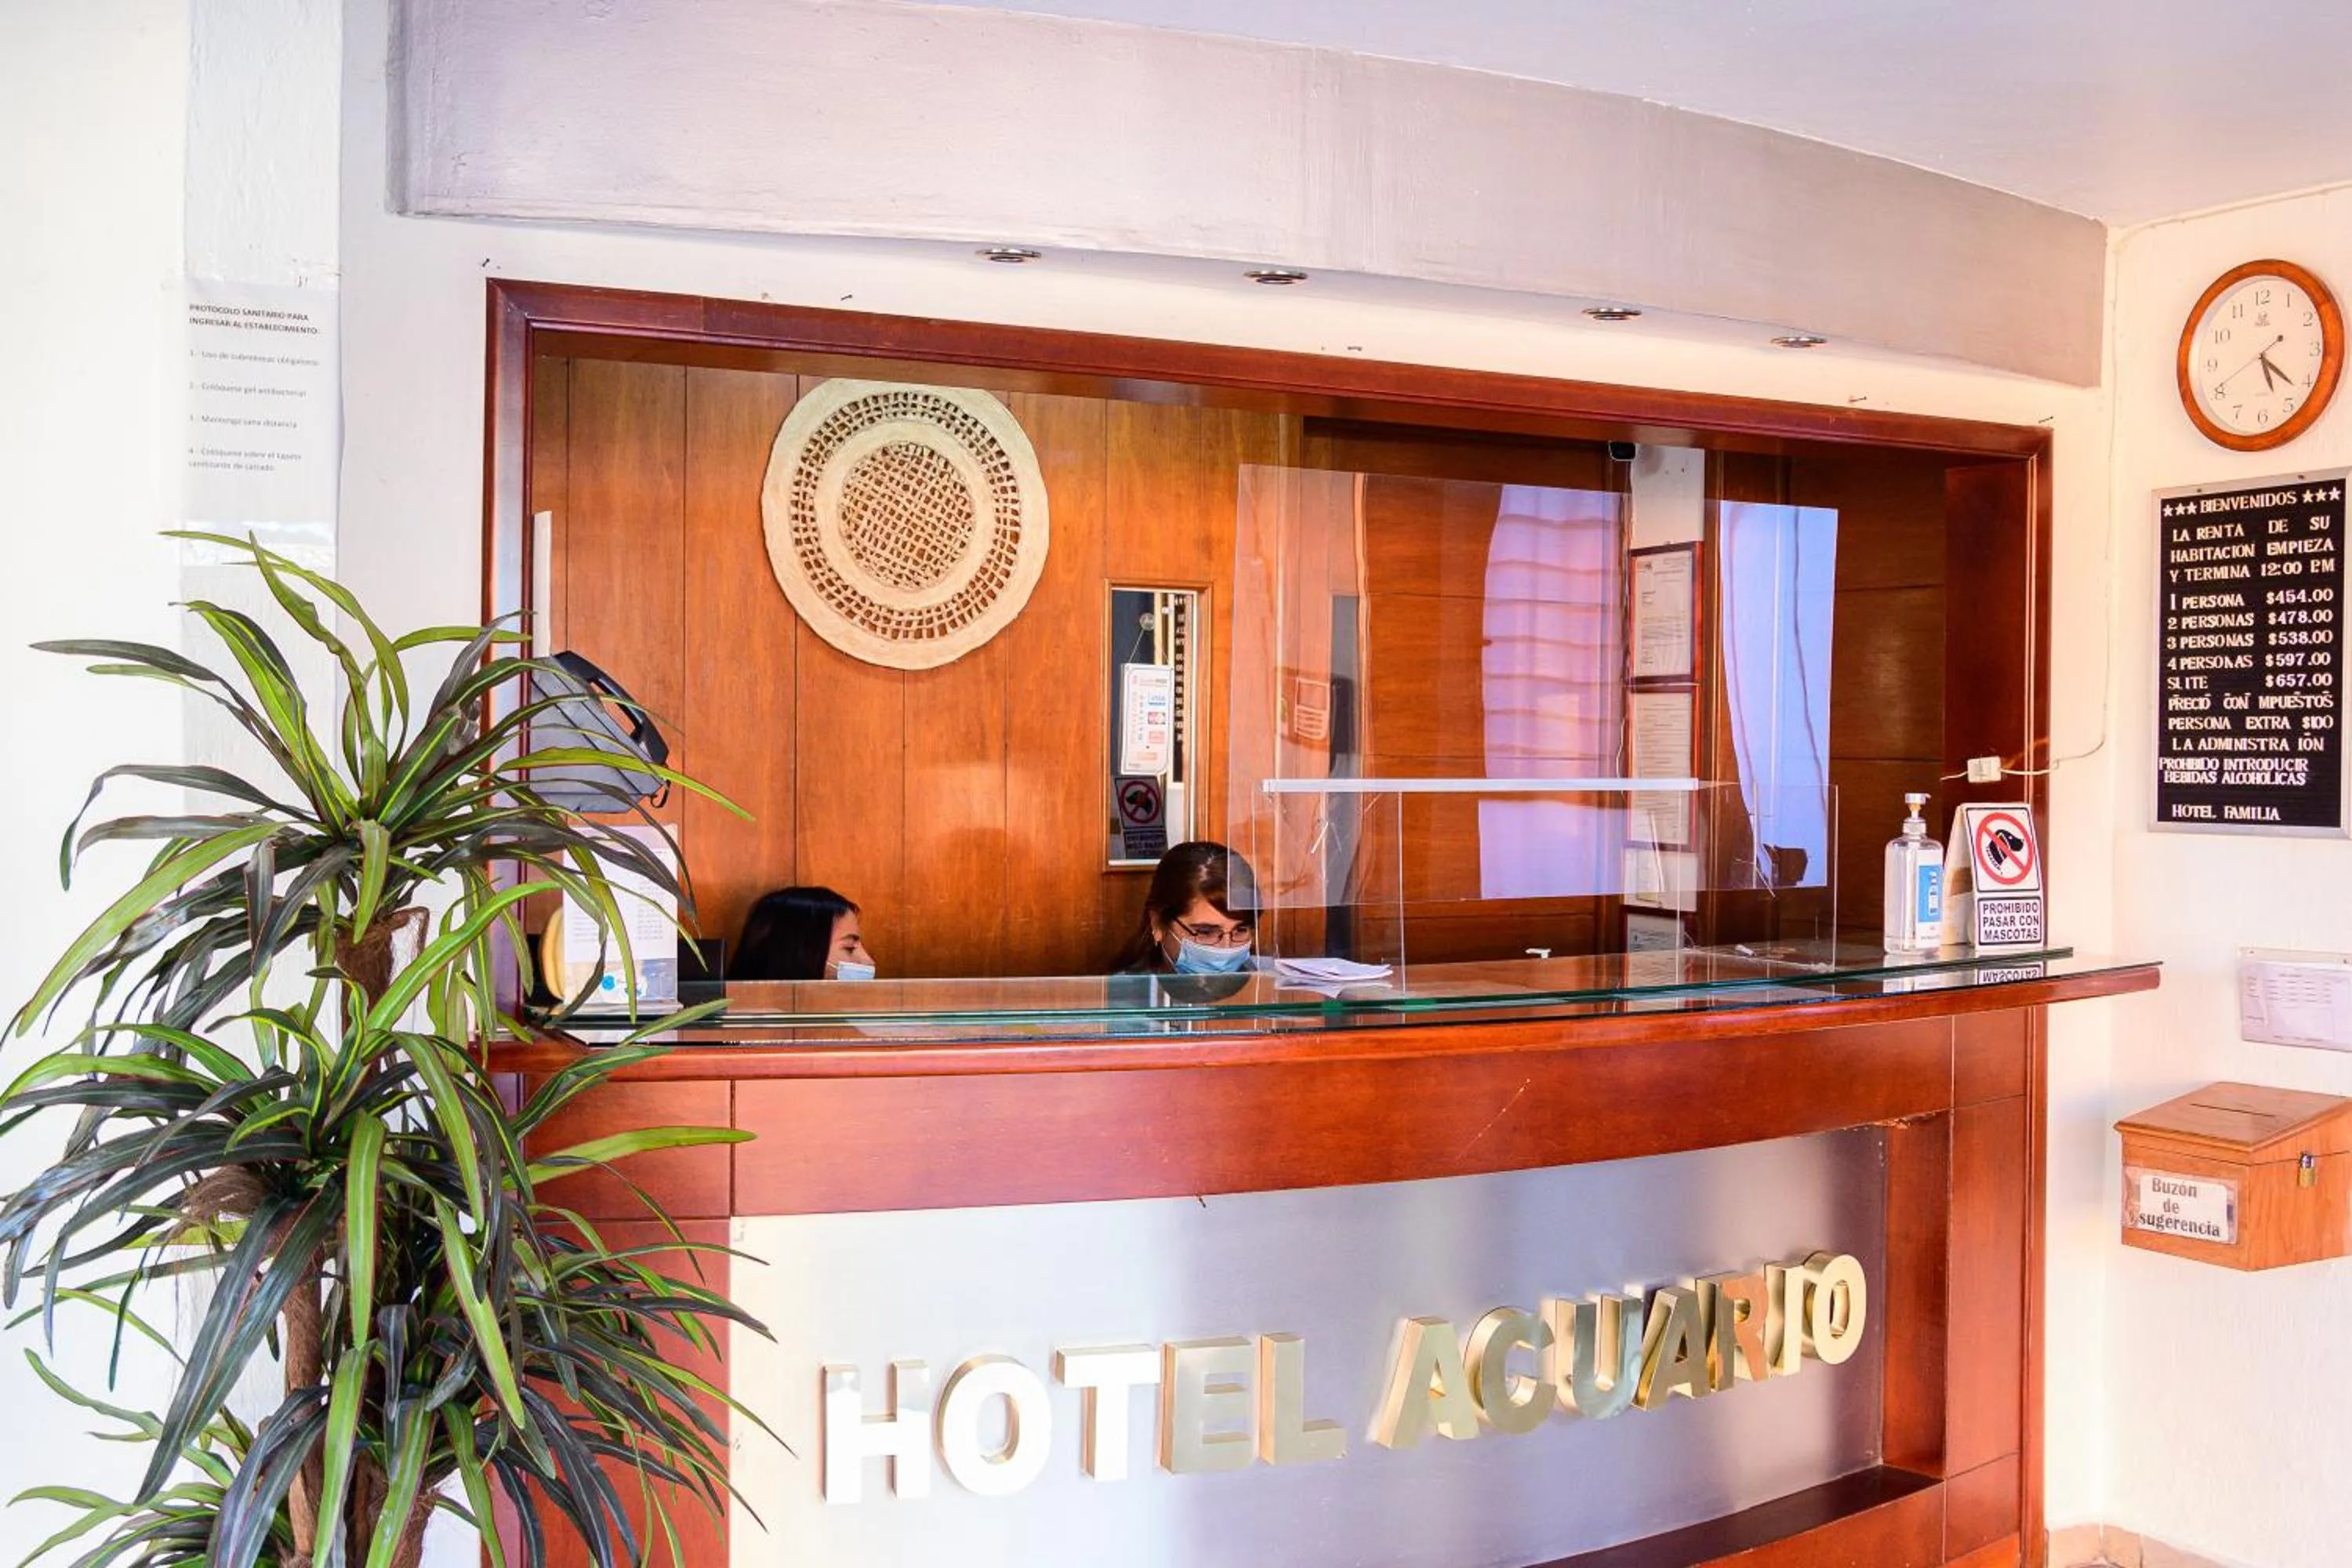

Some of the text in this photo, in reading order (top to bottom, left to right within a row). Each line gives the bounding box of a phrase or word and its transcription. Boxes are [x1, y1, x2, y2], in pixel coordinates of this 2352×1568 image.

[2256, 289, 2270, 305] 12
[2288, 293, 2290, 308] 1
[190, 304, 240, 315] PROTOCOLO
[242, 309, 285, 319] SANITARIO
[2233, 303, 2243, 318] 11
[190, 318, 230, 326] INGRESAR
[2303, 313, 2313, 326] 2
[2215, 329, 2230, 343] 10
[2310, 342, 2321, 356] 3
[2207, 358, 2218, 372] 9
[2302, 374, 2313, 387] 4
[2215, 386, 2226, 400] 8
[2233, 404, 2242, 419] 7
[2283, 397, 2293, 413] 5
[2258, 410, 2268, 425] 6
[2201, 491, 2297, 514] BIENVENIDOS
[2172, 516, 2330, 542] LA RENTA DE SU
[2171, 538, 2334, 563] HABITACION EMPIEZA
[2170, 570, 2179, 583] Y
[2184, 564, 2250, 582] TERMINA
[2260, 561, 2303, 576] 12:00
[2170, 589, 2333, 610] 1 PERSONA $454.00
[2168, 610, 2333, 630] 2 PERSONAS $478.00
[2167, 630, 2333, 649] 3 PERSONAS $538.00
[2167, 658, 2177, 670] 4
[2265, 652, 2331, 666] $597.00
[2265, 673, 2332, 688] $657.00
[2169, 715, 2333, 730] PERSONA EXTRA $100
[2158, 757, 2308, 771] PROHIBIDO INTRODUCIR
[2165, 771, 2307, 786] BEBIDAS ALCOHOLICAS
[2172, 804, 2281, 821] HOTEL FAMILIA
[1983, 902, 2038, 915] PROHIBIDO
[1983, 916, 2038, 927] PASAR CON
[1984, 928, 2038, 940] MASCOTAS
[2163, 1199, 2180, 1214] de
[2138, 1212, 2220, 1237] sugerencia
[819, 1250, 1867, 1504] HOTEL ACUARIO
